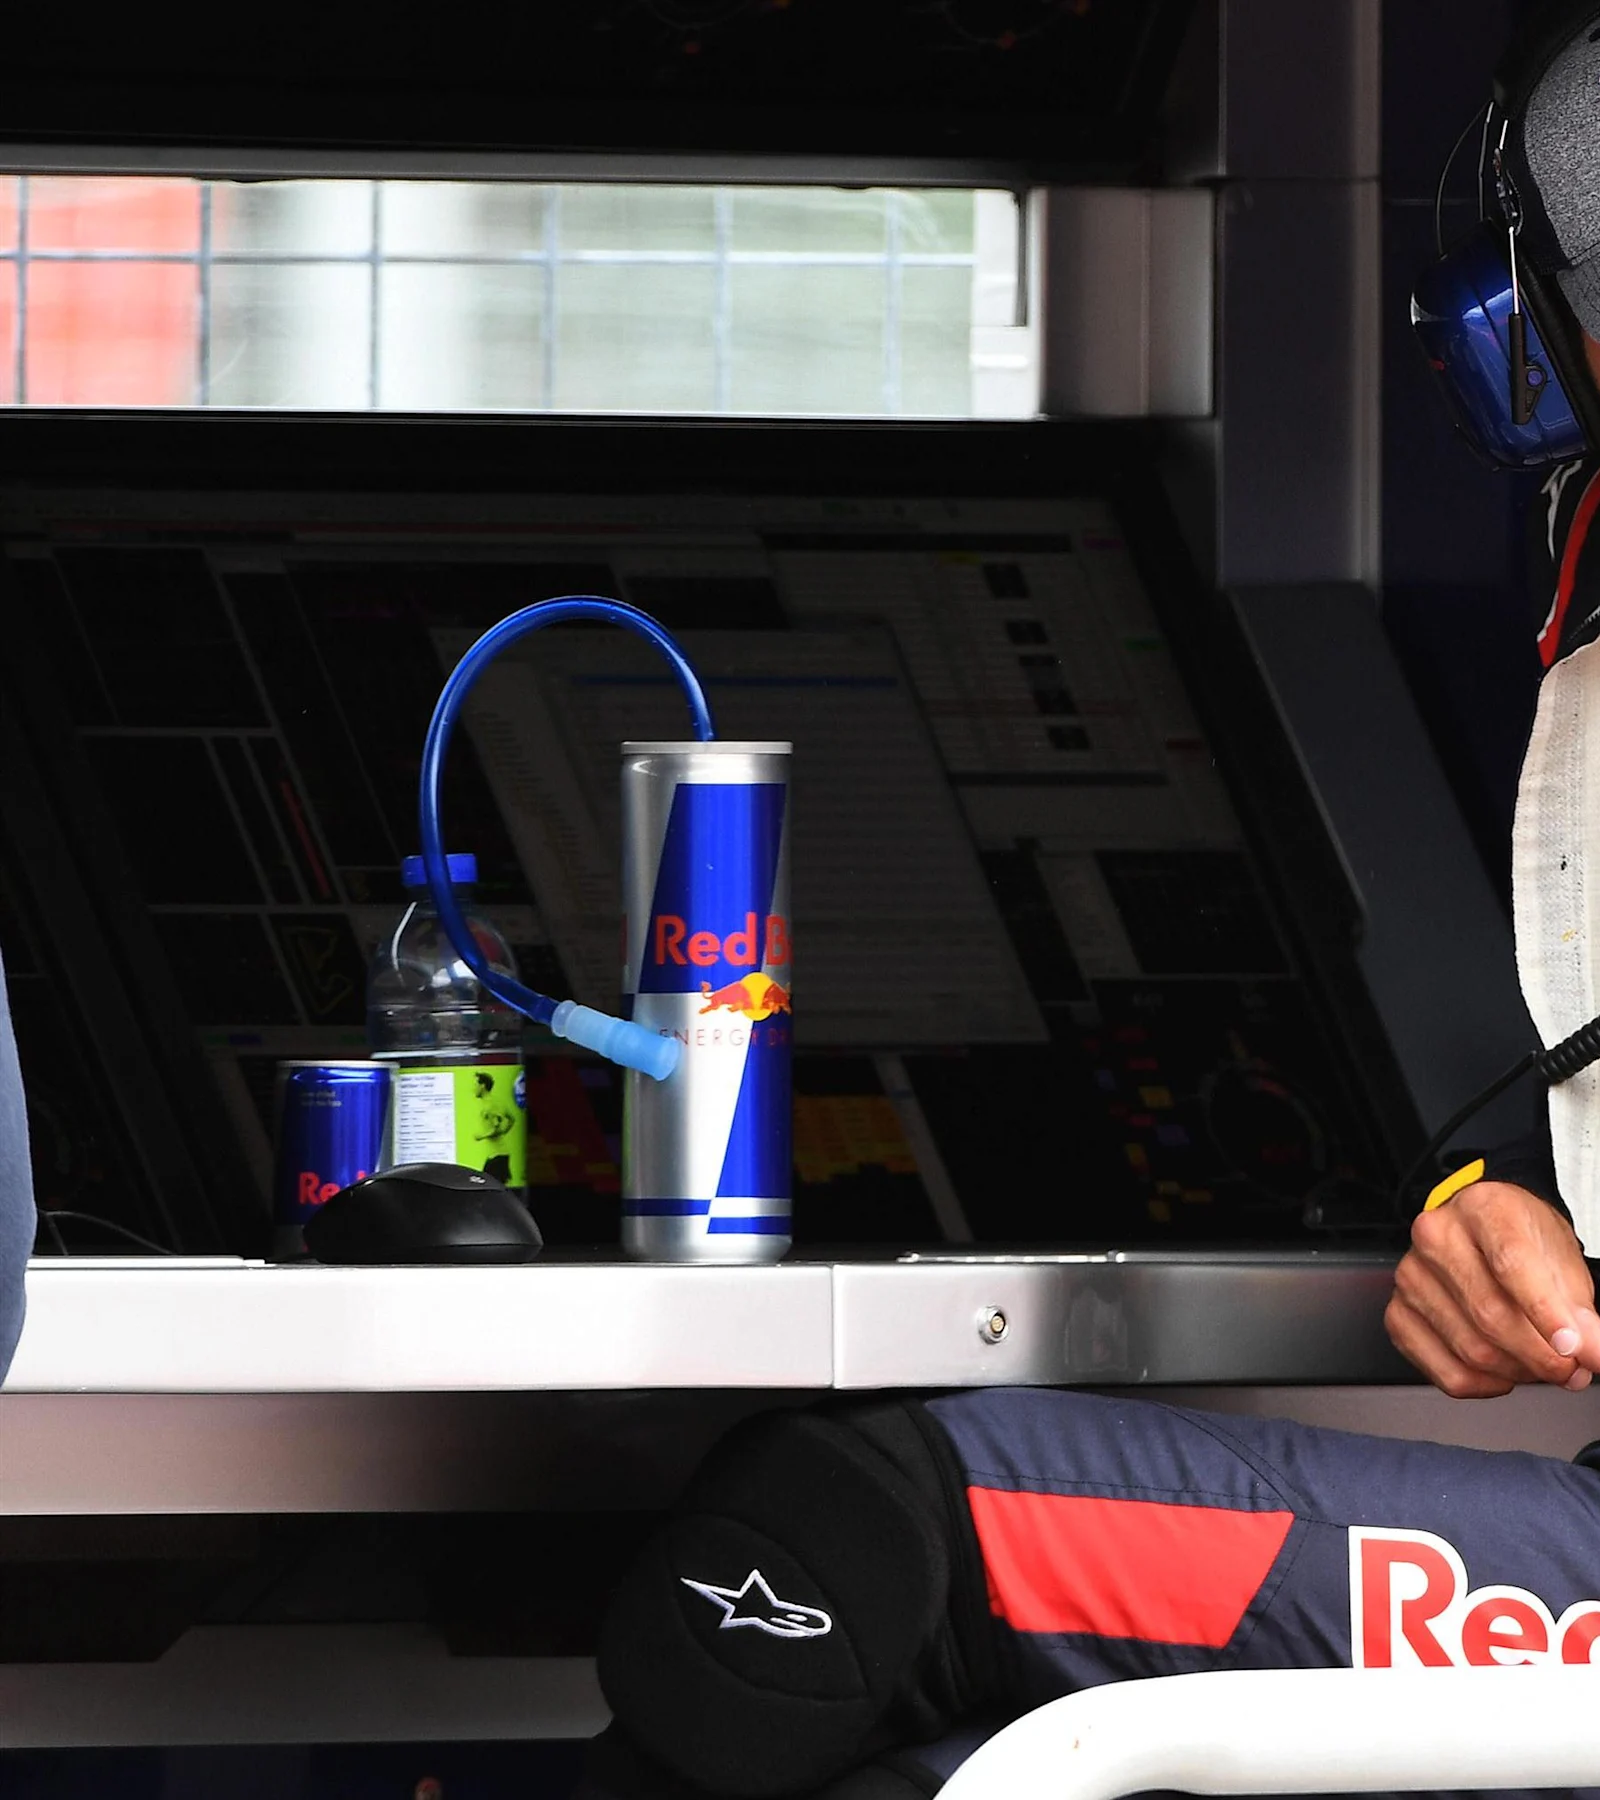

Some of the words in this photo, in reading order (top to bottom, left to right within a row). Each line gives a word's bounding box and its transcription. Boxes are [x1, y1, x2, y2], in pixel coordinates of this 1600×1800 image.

[656, 912, 757, 967] Red
[766, 914, 793, 967] B
[299, 1171, 367, 1204] Re
